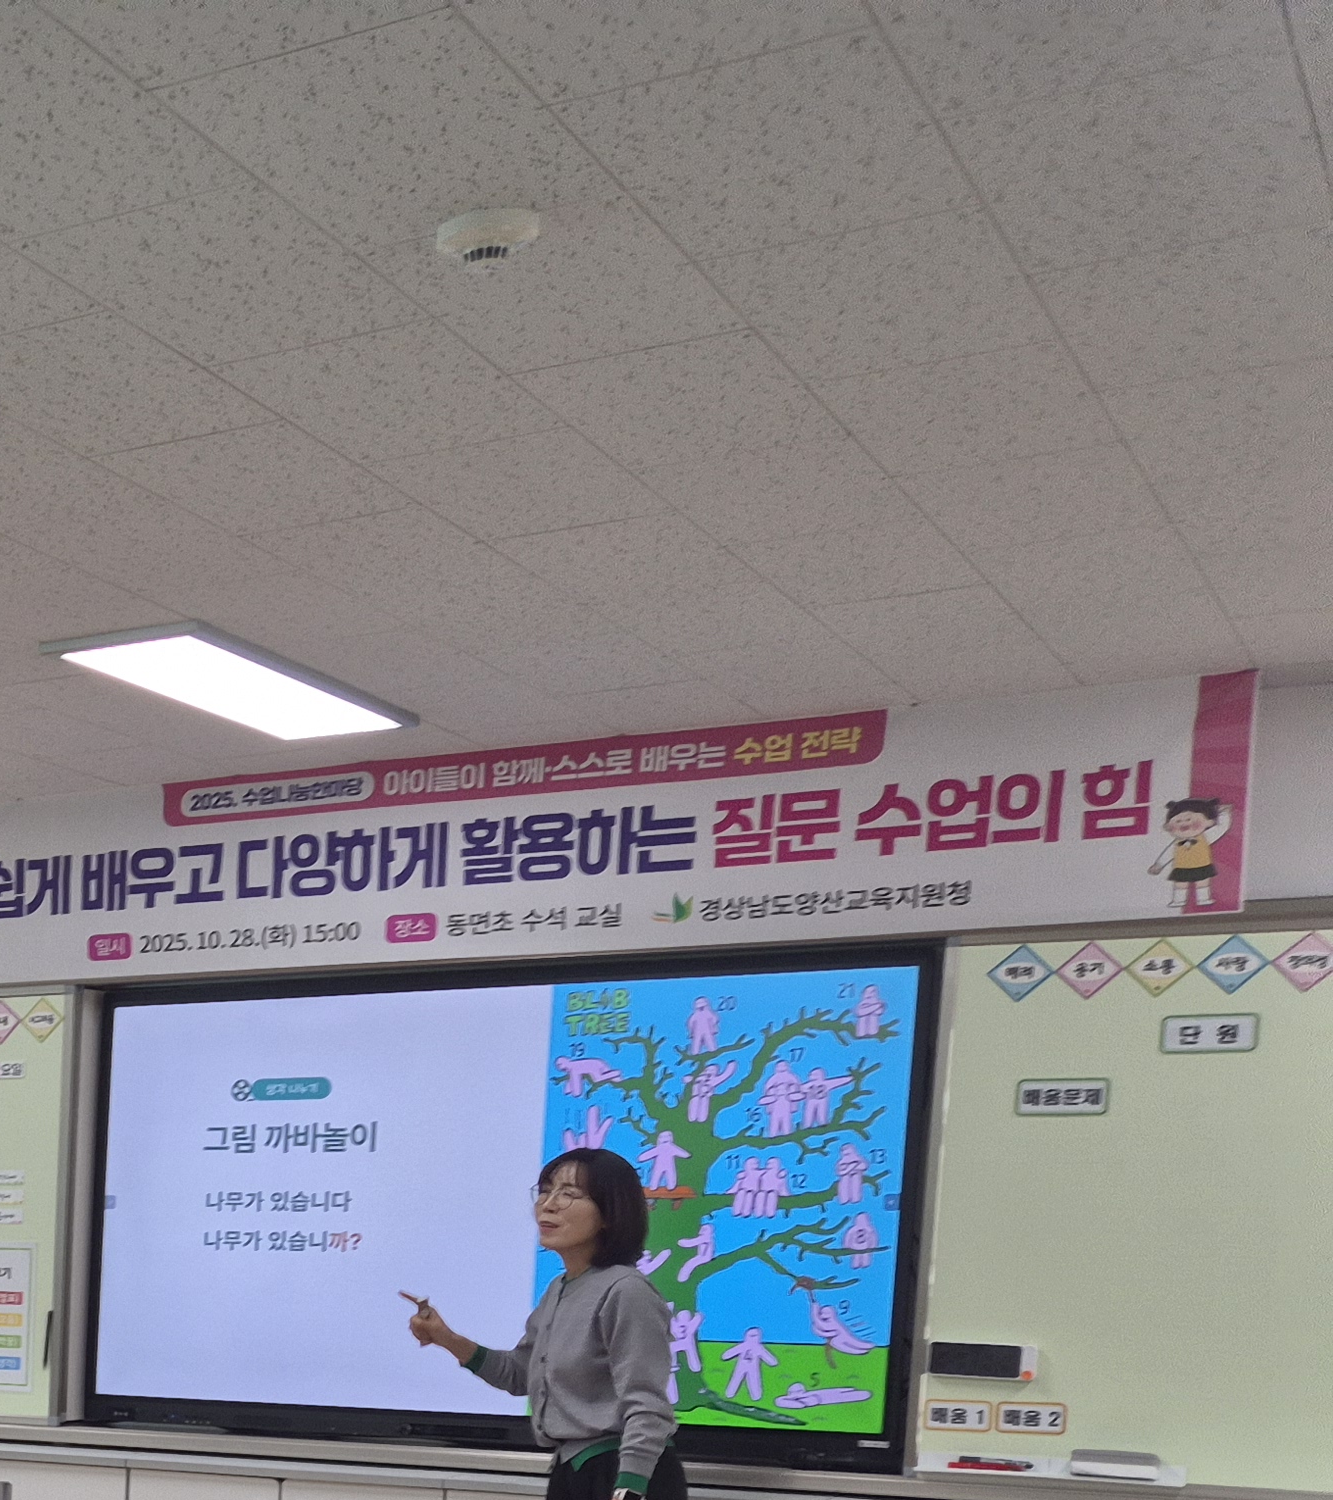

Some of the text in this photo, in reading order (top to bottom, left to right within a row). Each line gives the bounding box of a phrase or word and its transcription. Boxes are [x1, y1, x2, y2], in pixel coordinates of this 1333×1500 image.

[384, 760, 486, 797] 아이들이
[639, 741, 727, 774] 배우는
[734, 731, 795, 765] 수업
[800, 726, 863, 760] 전략
[80, 842, 225, 913] 배우고
[238, 821, 448, 902] 다양하게
[460, 805, 697, 886] 활용하는
[712, 787, 843, 868] 질문
[855, 768, 1066, 855] 수업의
[1081, 760, 1153, 841] 힘
[700, 881, 972, 924] 경상남도양산교육지원청
[393, 918, 430, 939] 장소
[446, 902, 622, 937] 동면초 수석 교실
[302, 921, 361, 944] 15:00
[94, 937, 126, 957] 일시
[565, 1012, 629, 1036] TREE
[790, 1047, 805, 1062] 17
[1022, 1088, 1104, 1107] 배움문제
[202, 1121, 379, 1154] 그림 까바놀이
[870, 1149, 887, 1164] 13
[792, 1174, 806, 1189] 12
[205, 1190, 352, 1213] 나무가 있습니다
[203, 1229, 362, 1252] 나무가 있습니까?
[838, 1300, 850, 1315] 9
[977, 1409, 985, 1425] 1
[1048, 1411, 1061, 1428] 2
